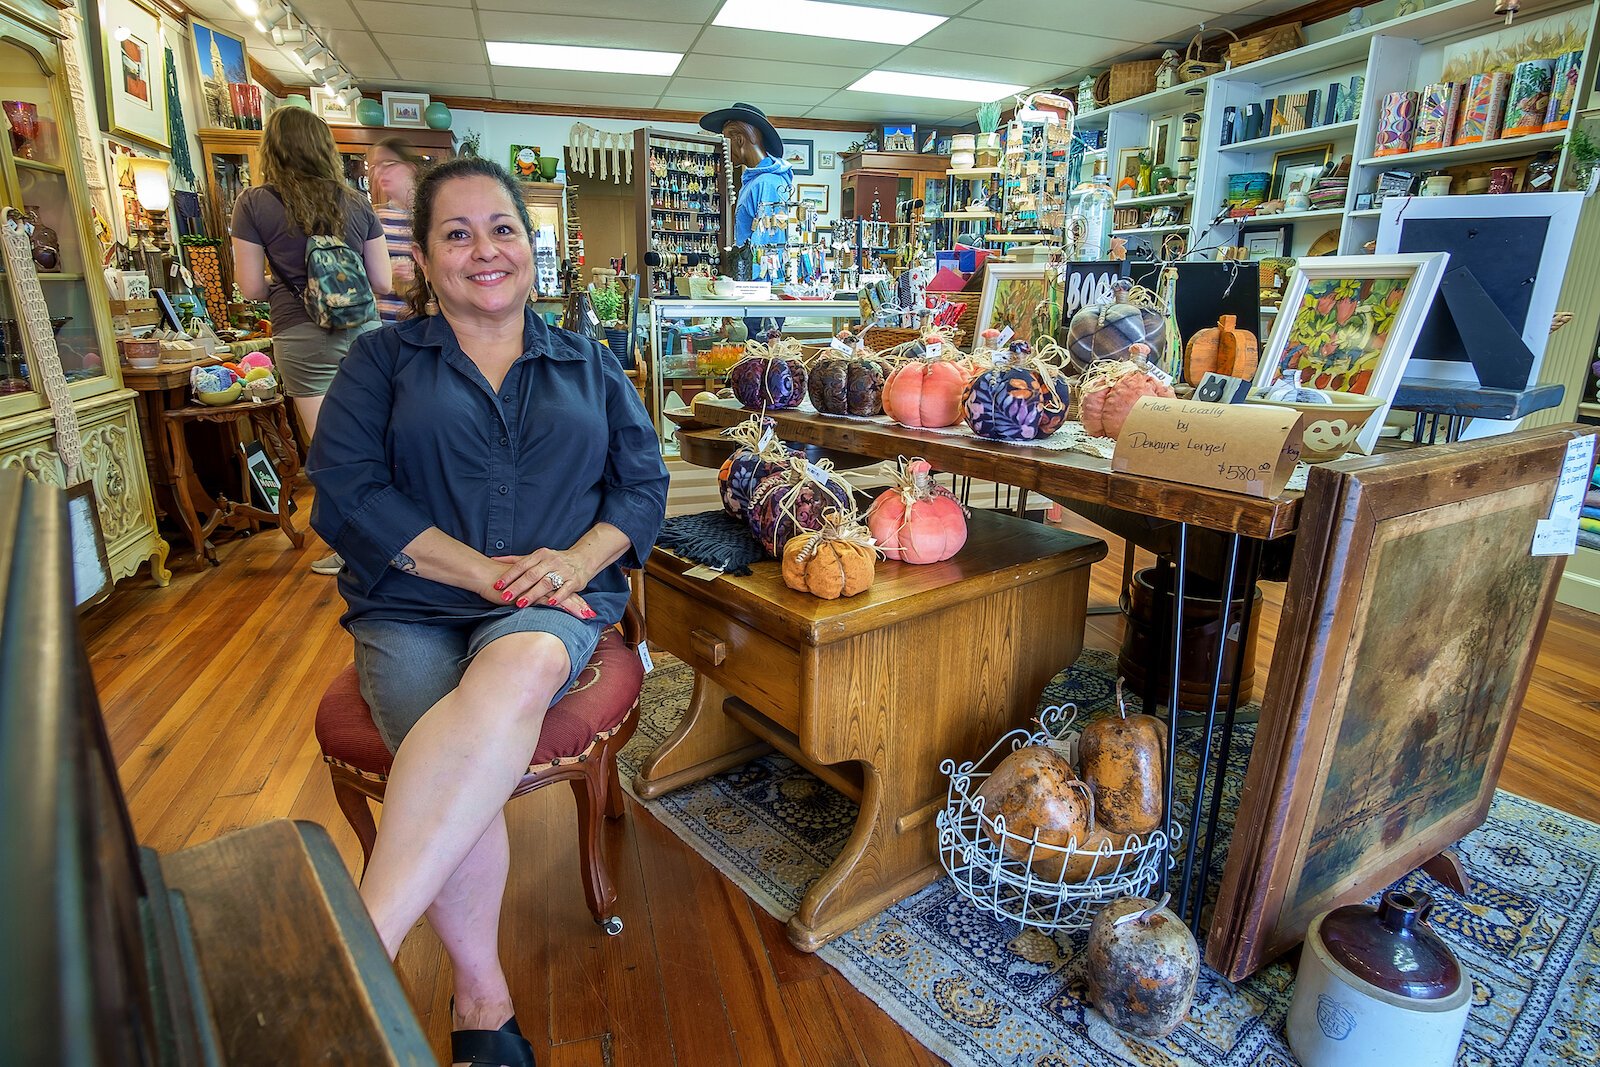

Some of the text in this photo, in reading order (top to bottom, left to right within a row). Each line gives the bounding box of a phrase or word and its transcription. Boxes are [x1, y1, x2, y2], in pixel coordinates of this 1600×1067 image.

[1142, 402, 1225, 418] Made Locally
[1176, 419, 1189, 433] by
[1187, 438, 1227, 456] Lengel
